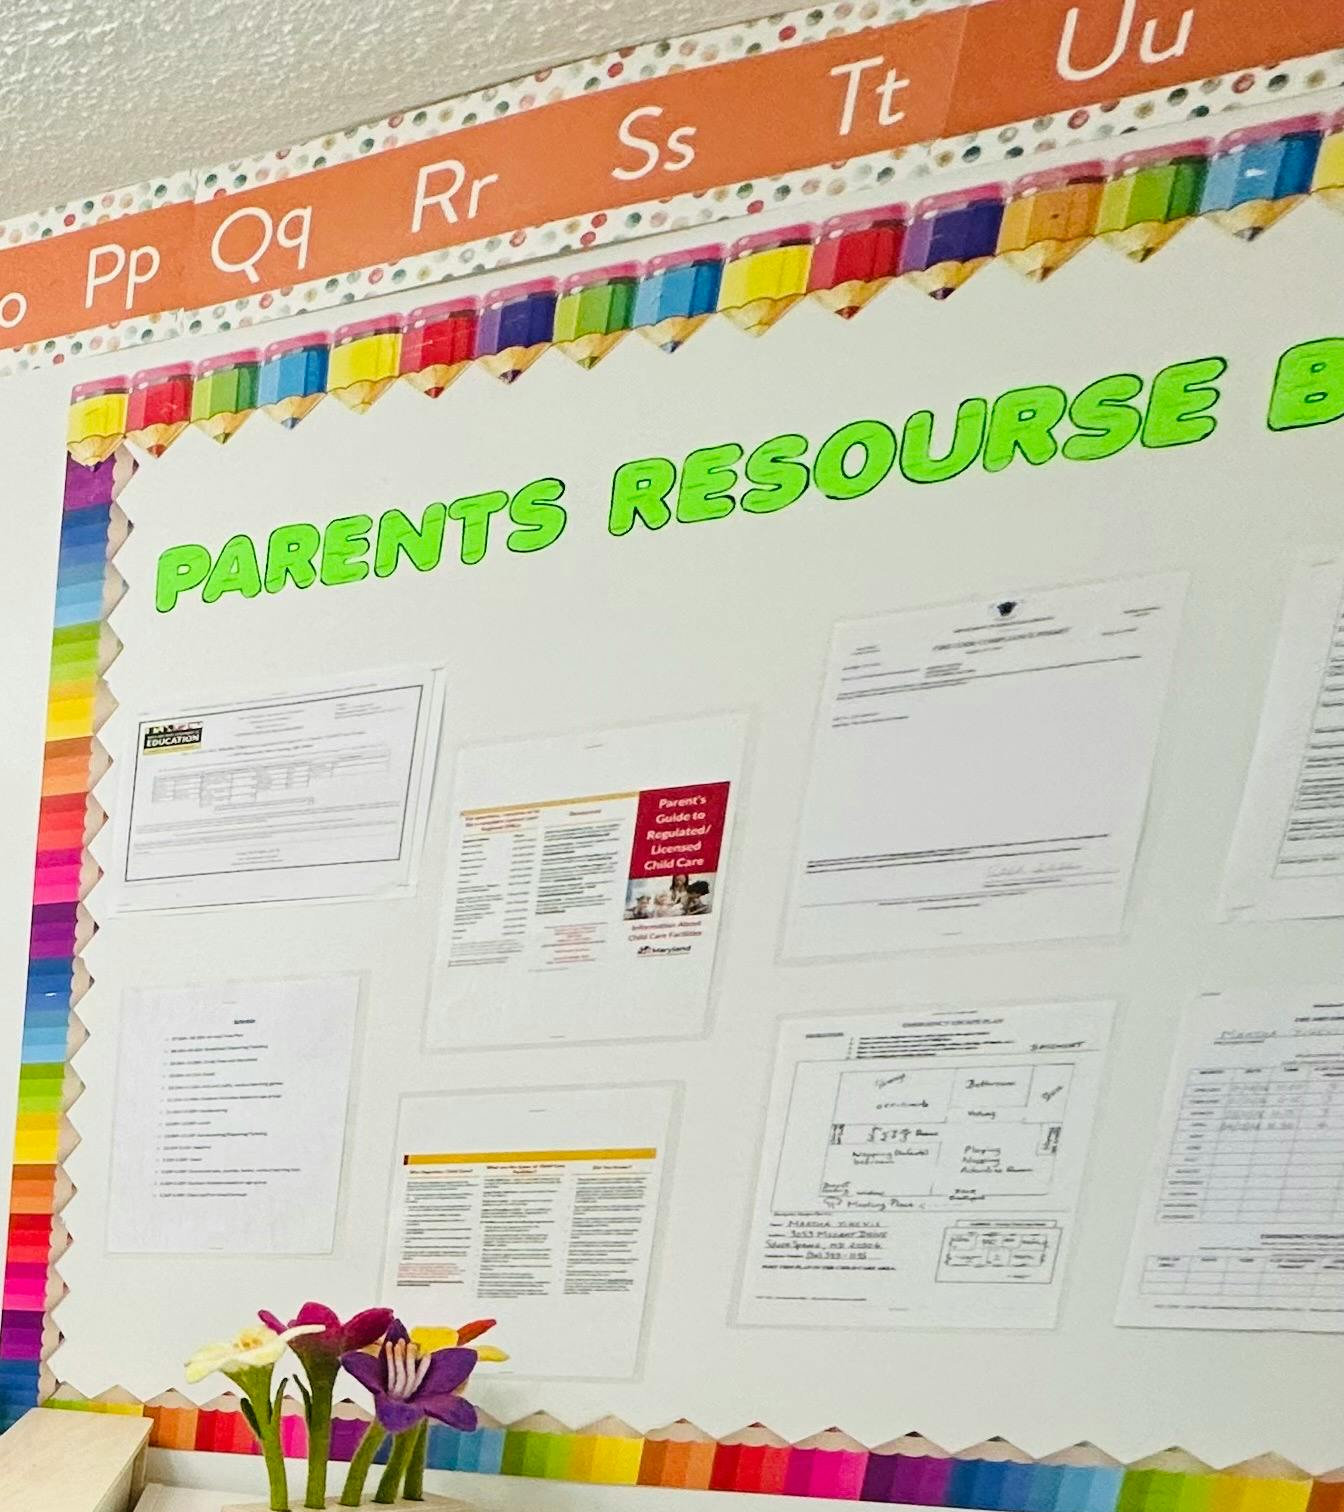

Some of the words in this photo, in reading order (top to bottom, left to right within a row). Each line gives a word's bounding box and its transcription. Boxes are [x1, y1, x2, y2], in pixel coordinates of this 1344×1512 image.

[85, 244, 160, 312] Pp
[209, 202, 313, 282] Qq
[411, 160, 499, 234] Rr
[611, 107, 696, 180] Ss
[830, 56, 910, 135] Tt
[1056, 5, 1192, 82] Uu
[156, 478, 567, 613] PARENTS
[608, 357, 1227, 536] RESOURSE
[658, 795, 707, 809] Parent's
[656, 813, 690, 824] Guide
[692, 812, 706, 820] to
[651, 841, 702, 856] Licensed
[644, 859, 674, 871] Child
[676, 857, 704, 867] Care
